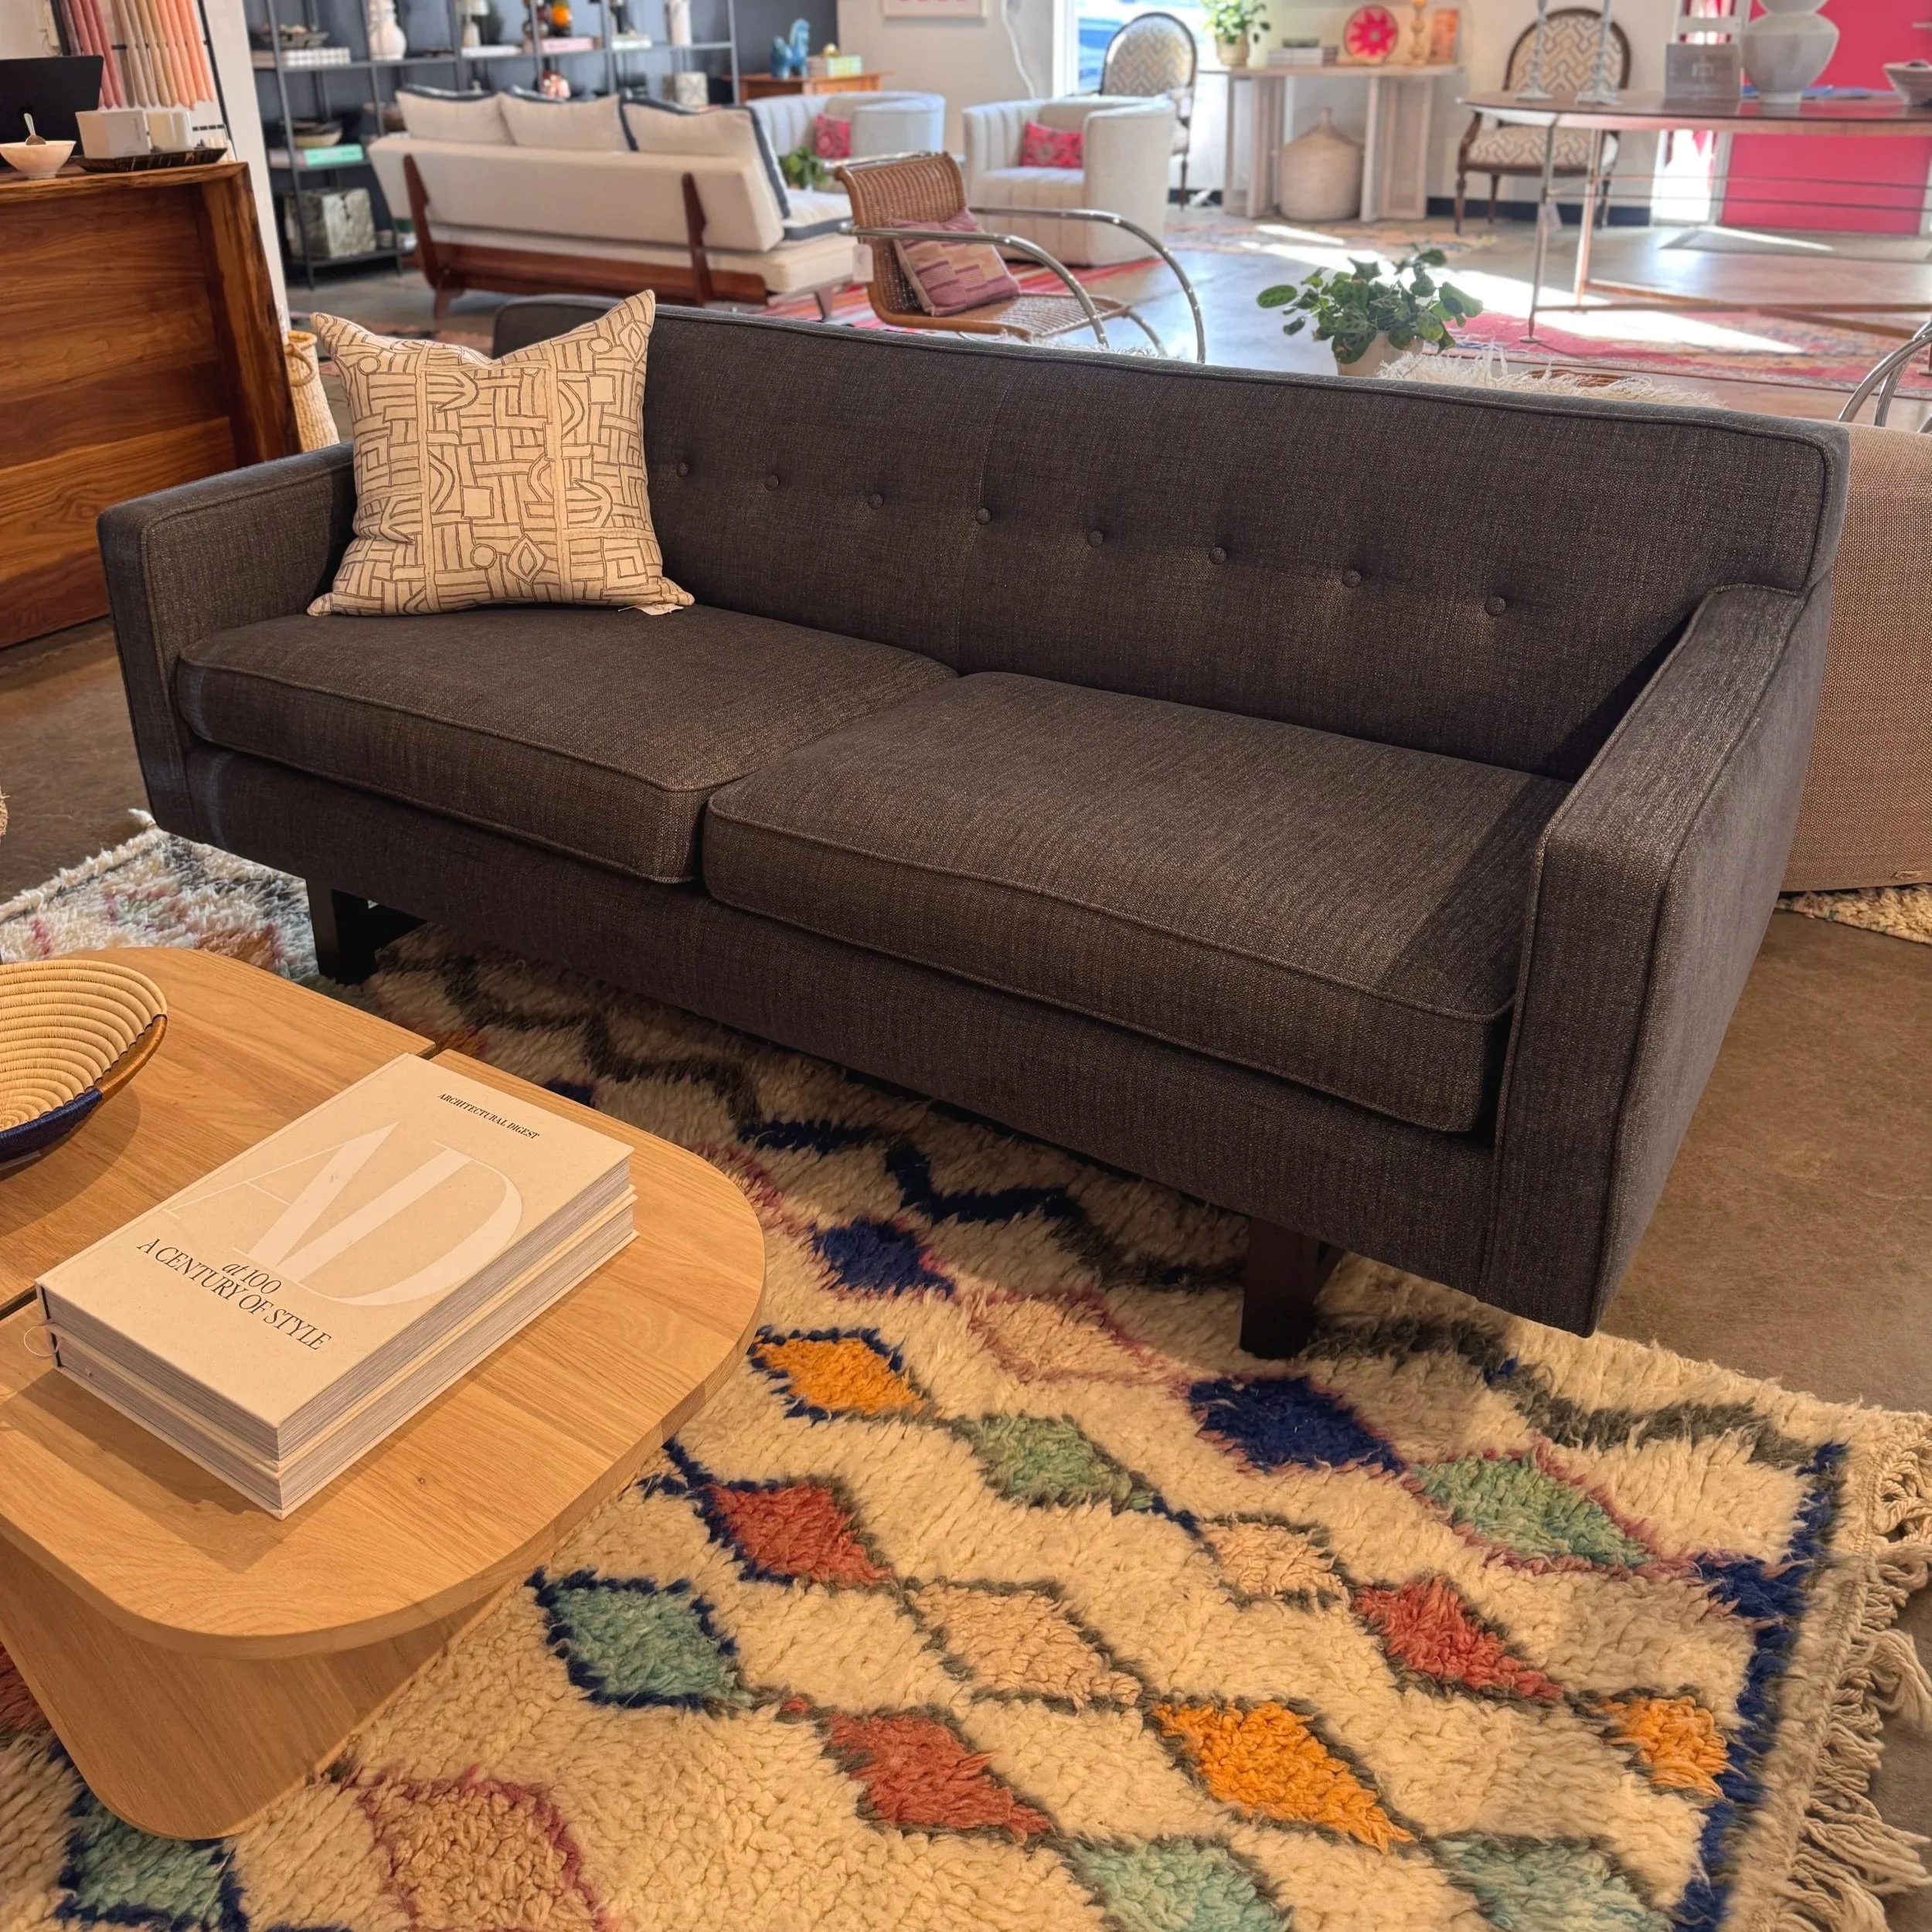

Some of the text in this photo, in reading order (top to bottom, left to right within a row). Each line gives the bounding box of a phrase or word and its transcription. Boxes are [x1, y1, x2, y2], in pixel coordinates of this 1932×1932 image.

[437, 1093, 540, 1140] ARCHITECTURAL DIGEST
[162, 1121, 522, 1306] AD
[136, 1238, 332, 1351] A CENTURY OF STYLE
[222, 1263, 282, 1294] at 100
